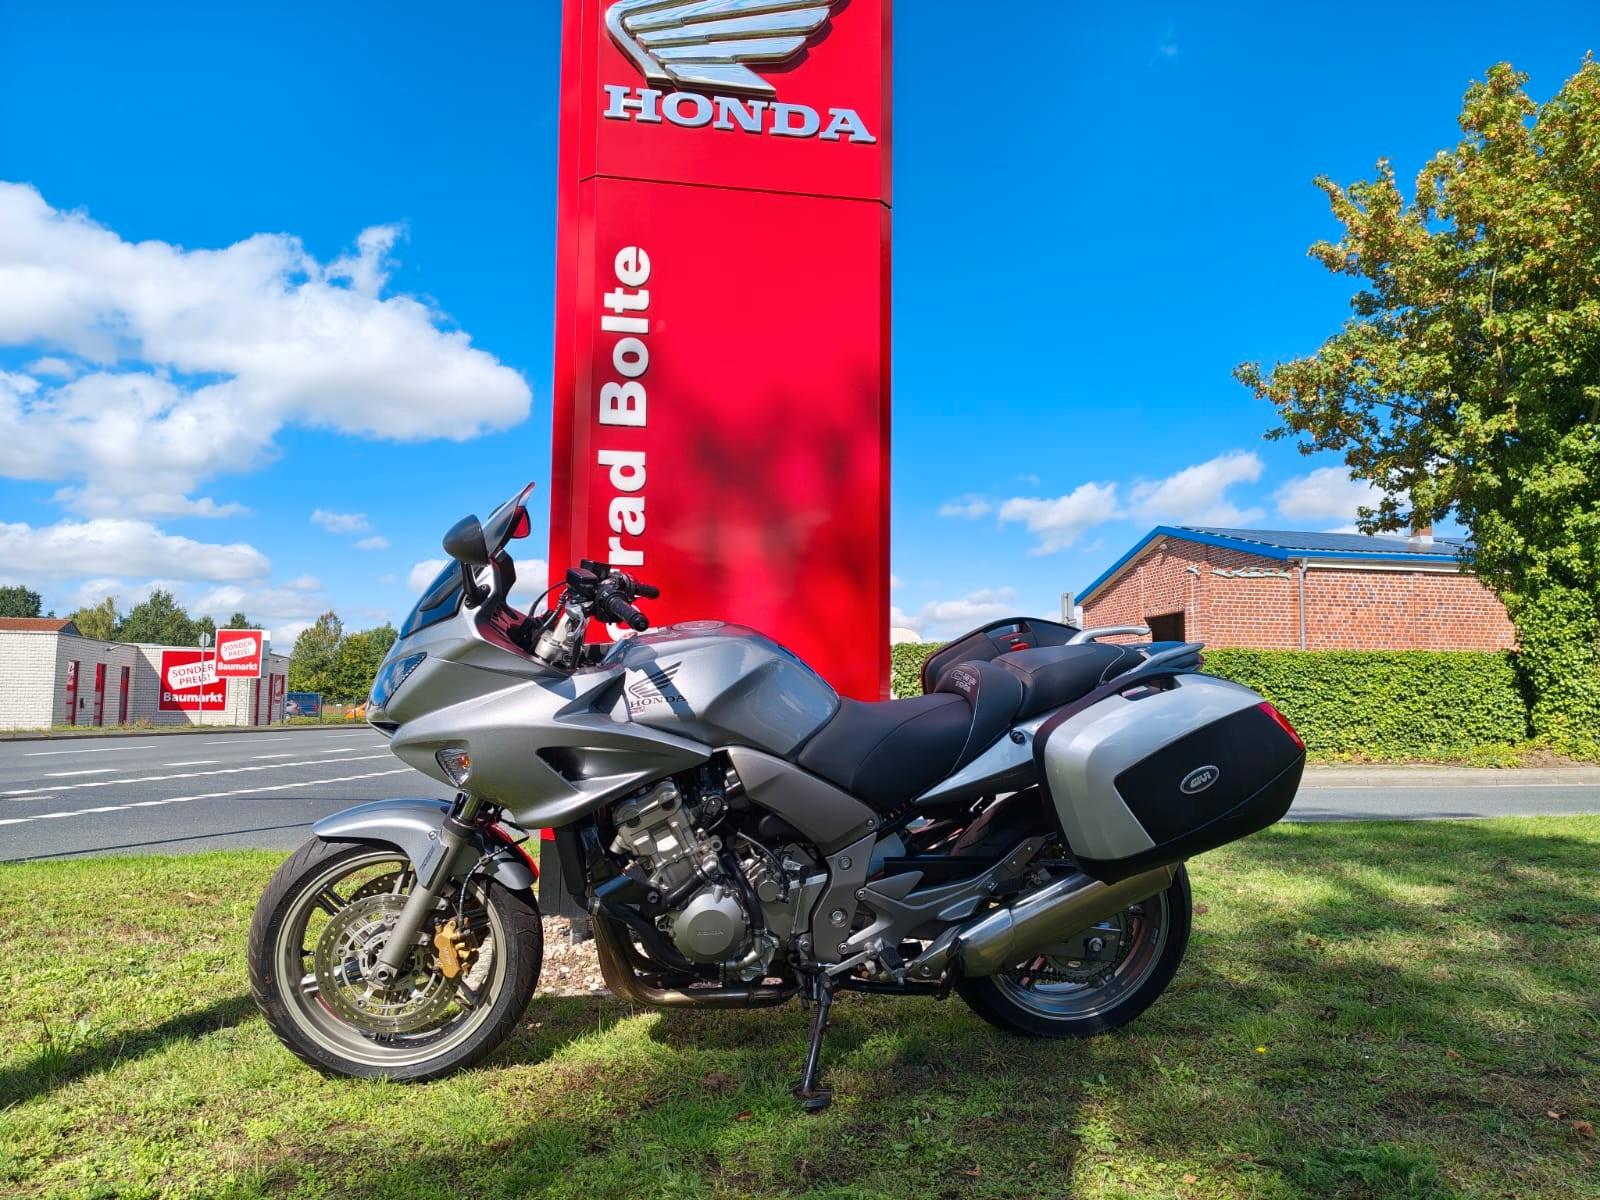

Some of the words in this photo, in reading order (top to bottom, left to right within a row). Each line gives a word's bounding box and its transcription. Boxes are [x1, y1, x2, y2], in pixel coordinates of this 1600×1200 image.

[603, 84, 877, 143] HONDA
[598, 246, 652, 427] Bolte
[223, 640, 252, 651] SONDER
[172, 663, 214, 678] SONDER
[217, 662, 258, 671] Baumarkt
[179, 673, 211, 685] PREIS!
[163, 692, 223, 703] Baumarkt
[630, 695, 687, 708] HONDA
